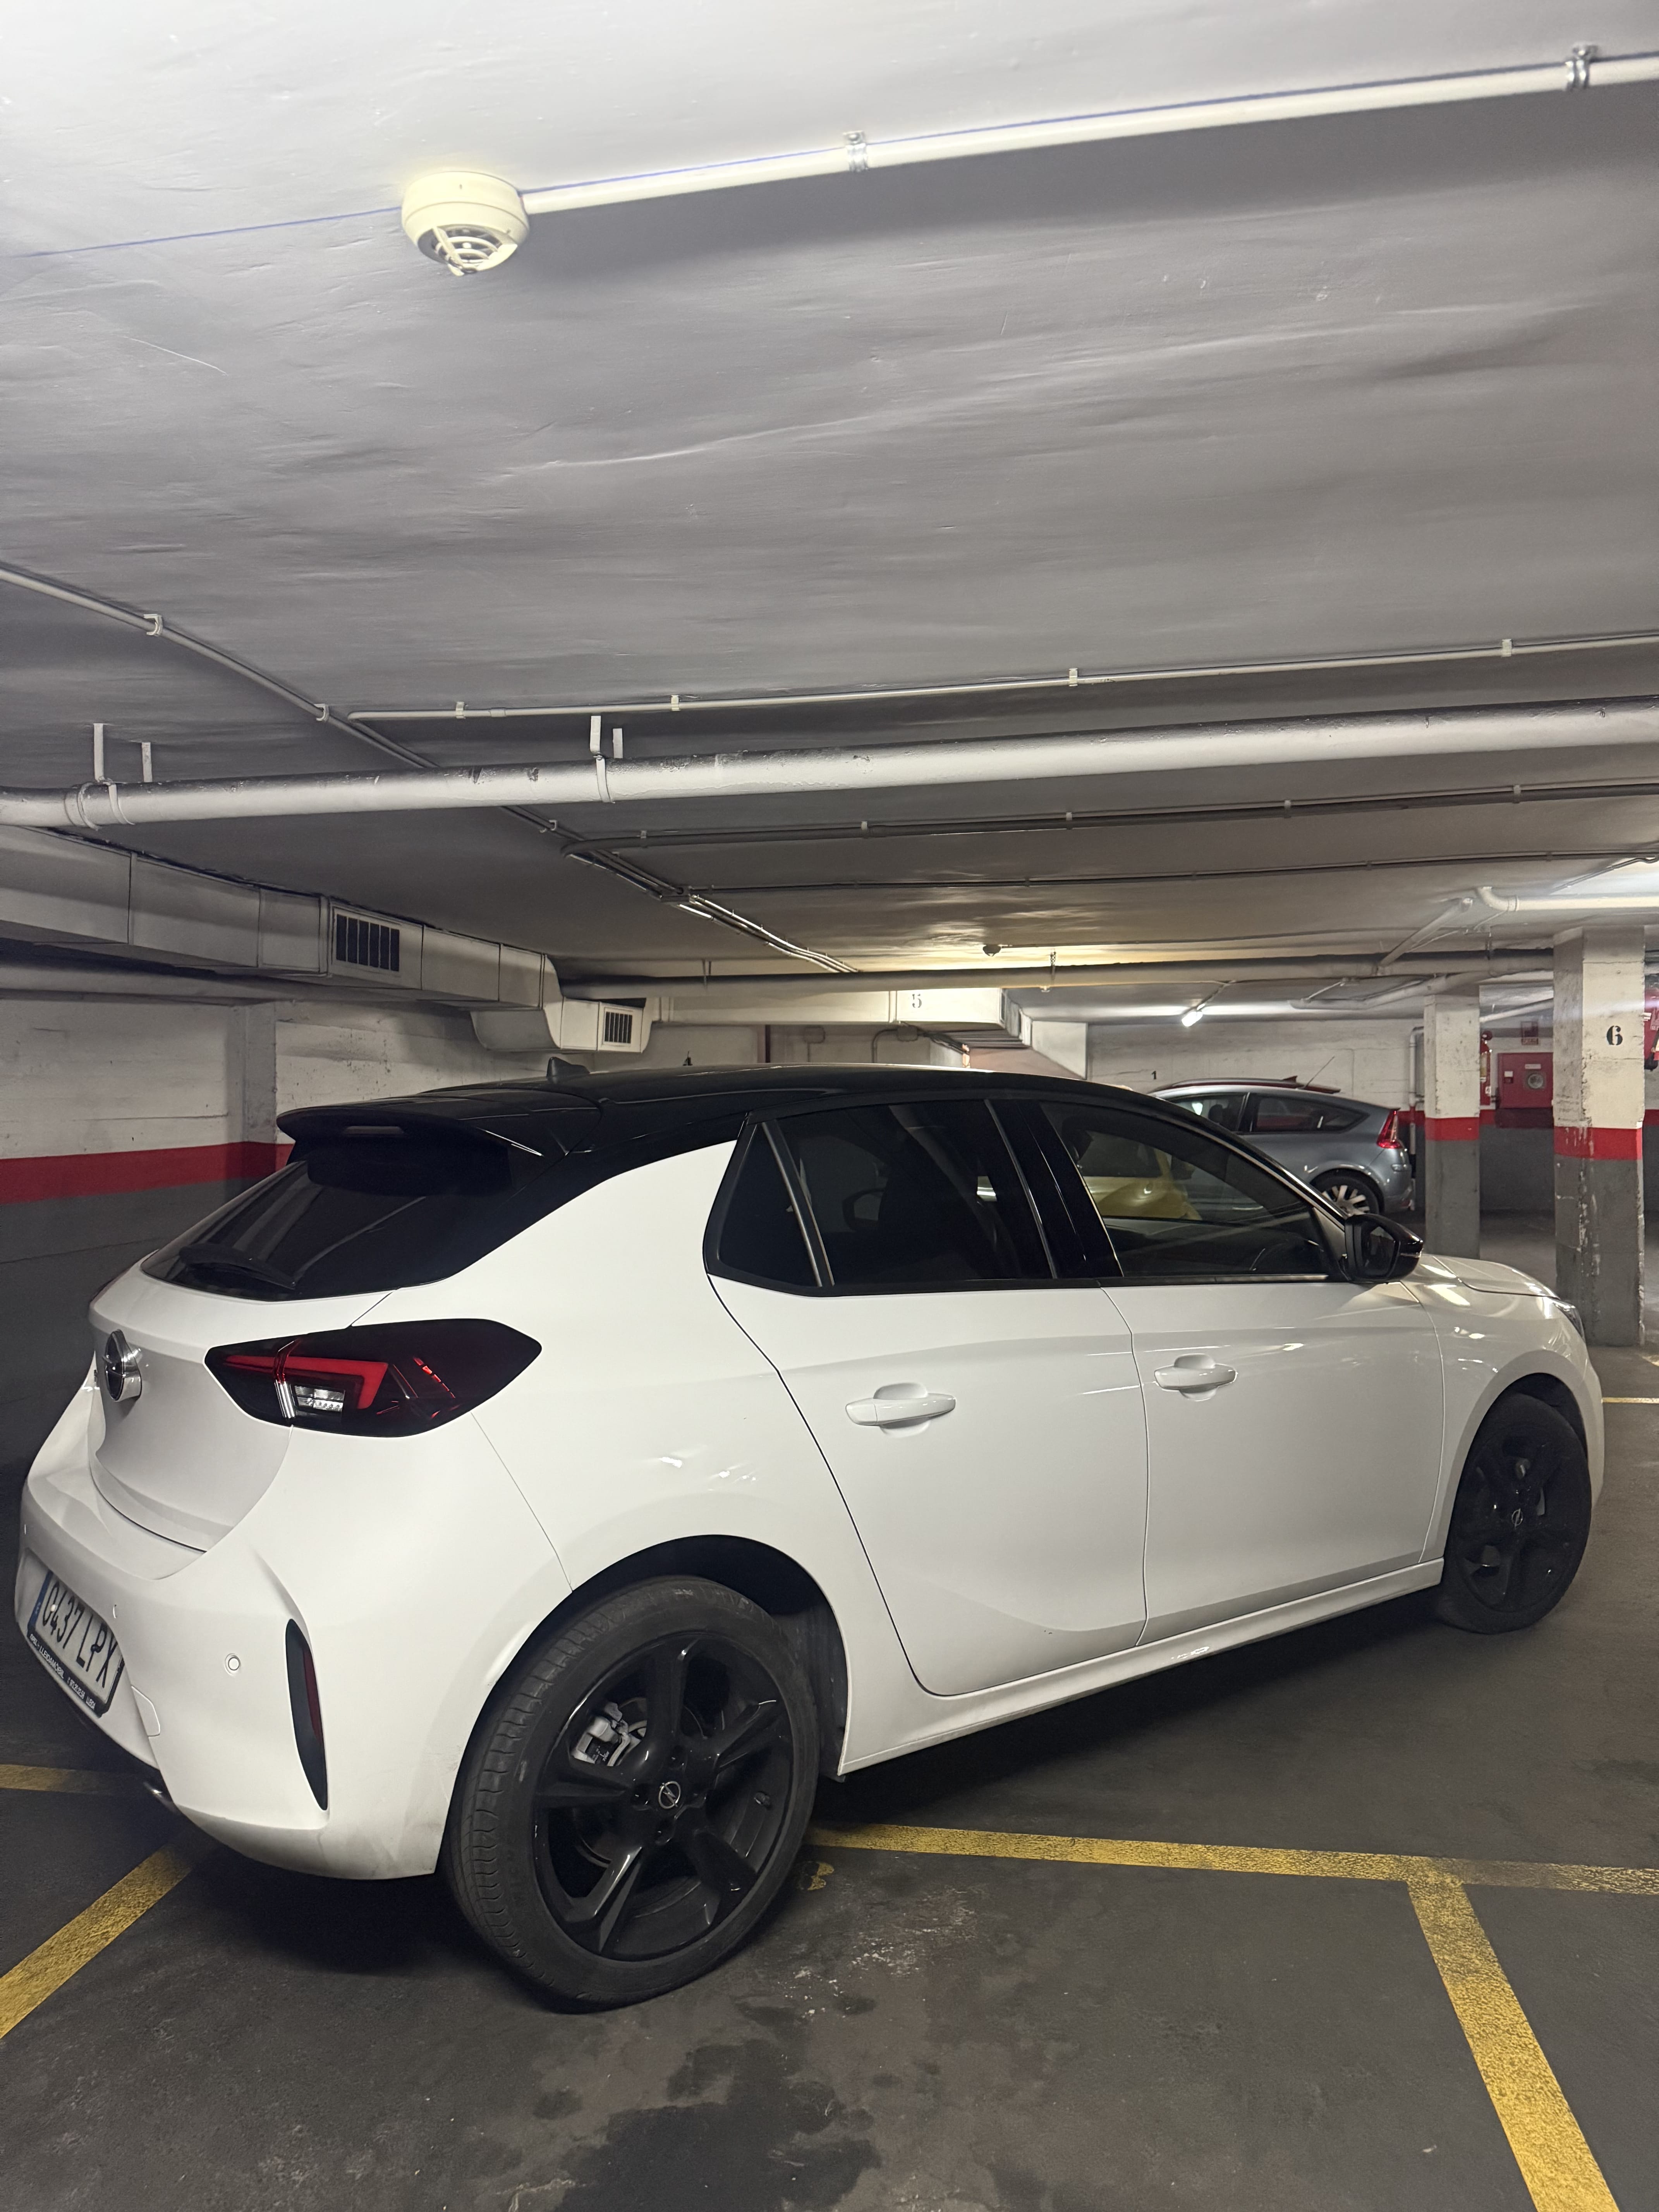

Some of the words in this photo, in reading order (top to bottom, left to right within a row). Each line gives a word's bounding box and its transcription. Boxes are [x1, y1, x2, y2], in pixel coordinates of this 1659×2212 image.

[912, 993, 922, 1008] 5
[1606, 1025, 1623, 1046] 6
[1151, 1070, 1157, 1080] 1
[43, 1581, 85, 1649] 0437
[76, 1613, 118, 1688] LPX
